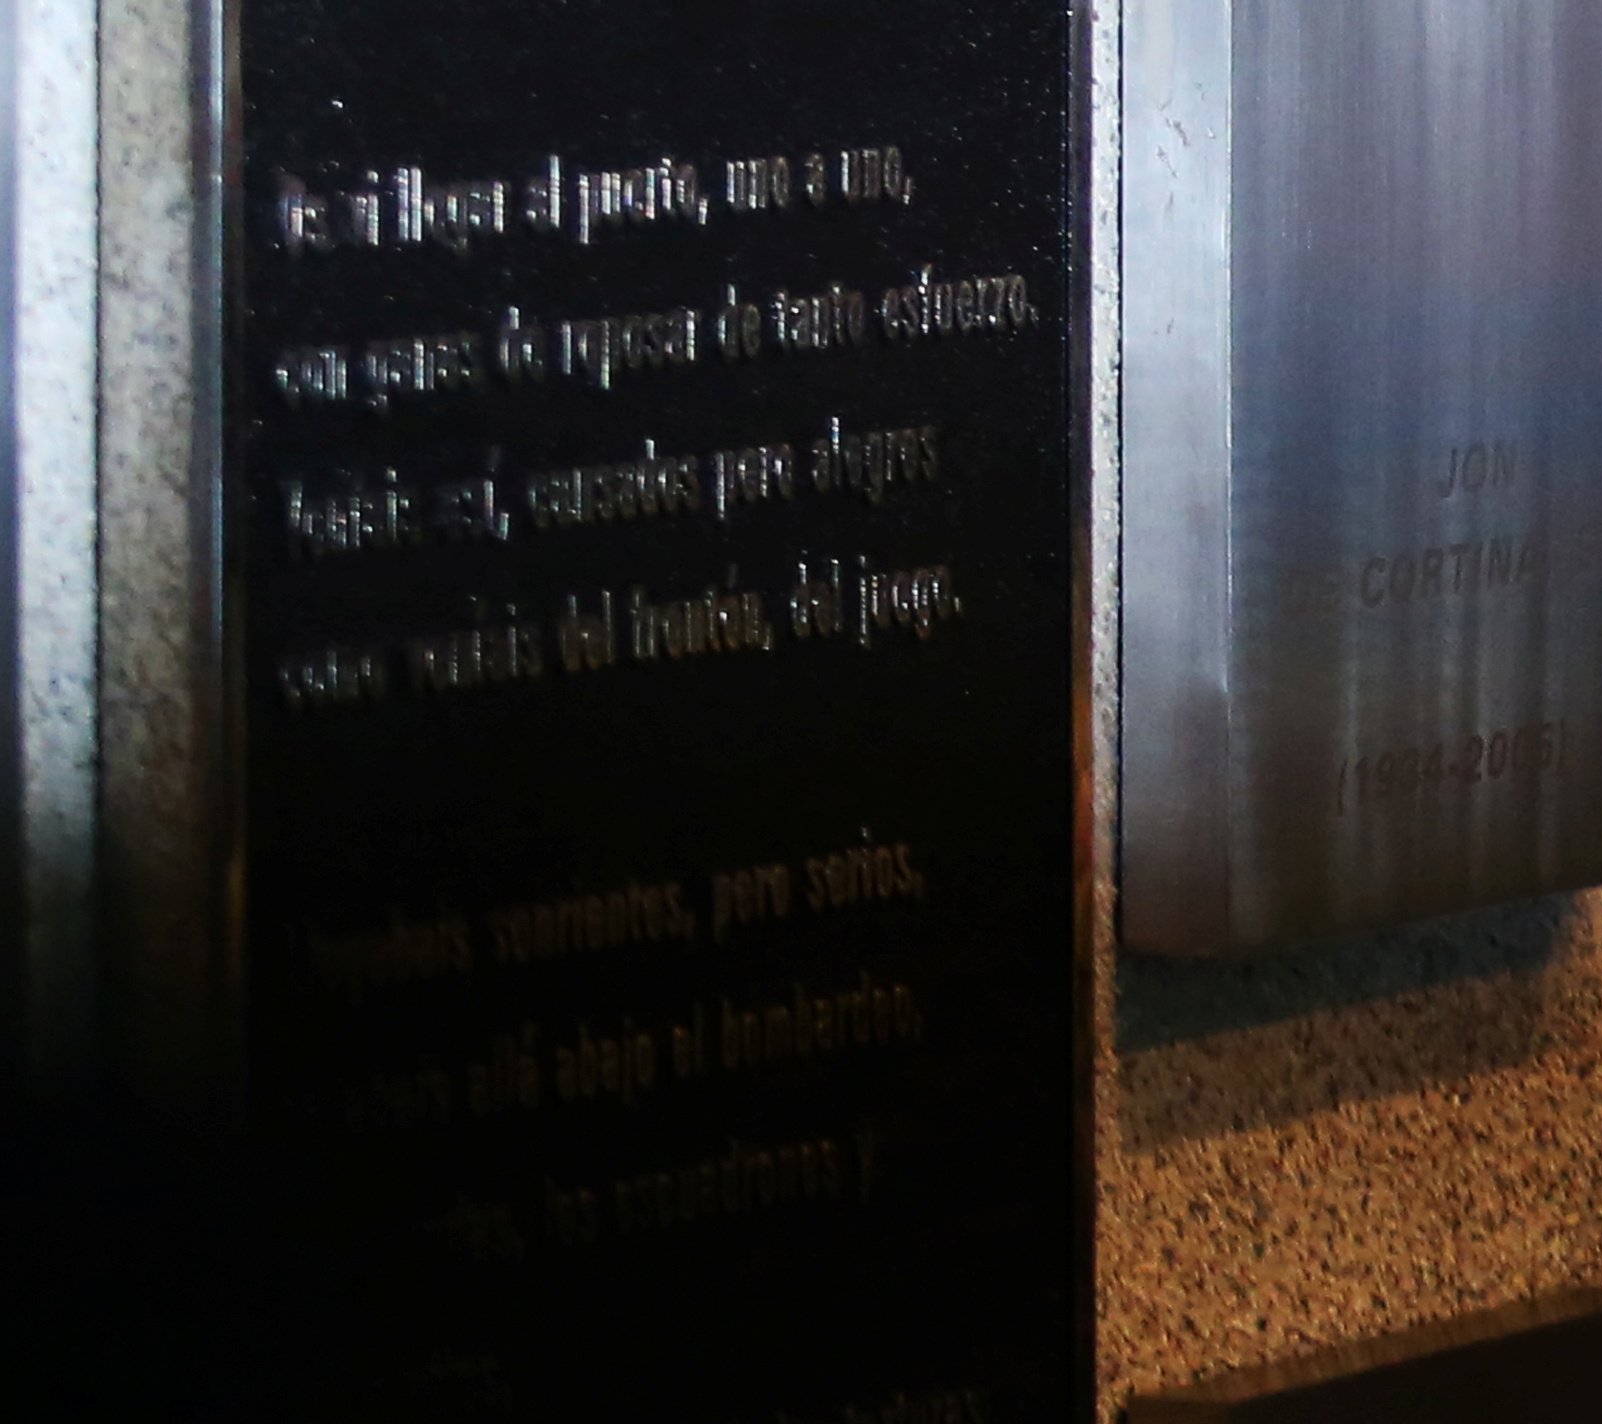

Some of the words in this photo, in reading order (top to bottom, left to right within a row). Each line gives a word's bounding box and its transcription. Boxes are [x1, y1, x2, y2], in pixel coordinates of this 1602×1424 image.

[523, 152, 562, 231] al
[722, 154, 790, 212] uno
[803, 151, 826, 208] a
[839, 143, 916, 206] uno,
[716, 282, 763, 359] de
[713, 442, 795, 522] pero
[811, 415, 941, 506] alegres
[1438, 442, 1519, 499] JON
